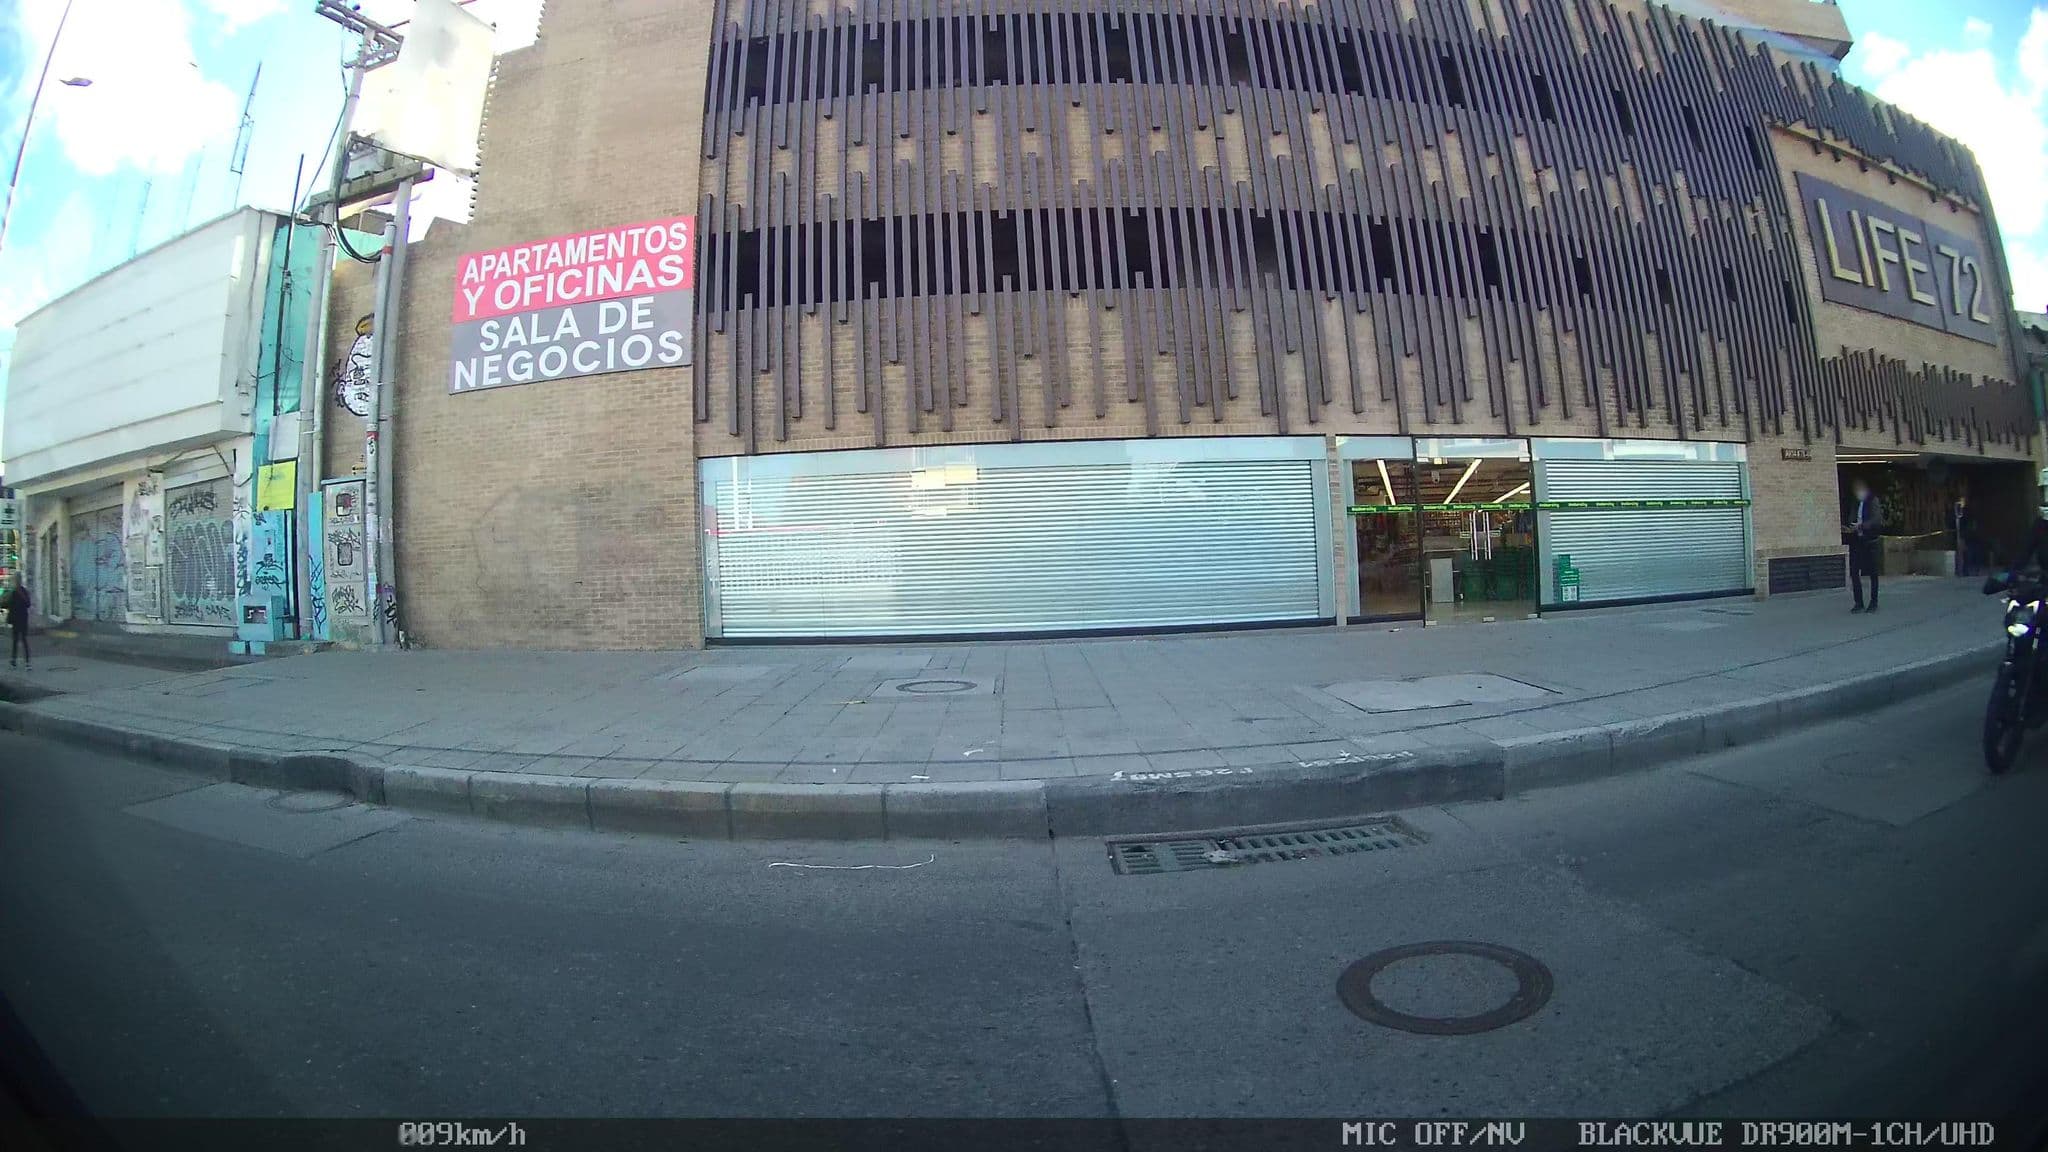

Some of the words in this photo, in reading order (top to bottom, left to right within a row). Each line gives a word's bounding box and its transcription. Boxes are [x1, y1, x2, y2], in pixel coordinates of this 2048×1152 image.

[462, 222, 688, 285] APARTAMENTOS
[1817, 198, 1936, 306] LIFE
[1936, 243, 1990, 324] 72
[463, 285, 485, 316] Y
[494, 254, 685, 311] OFICINAS
[479, 307, 581, 352] SALA
[598, 296, 655, 335] DE
[454, 330, 684, 390] NEGOCIOS
